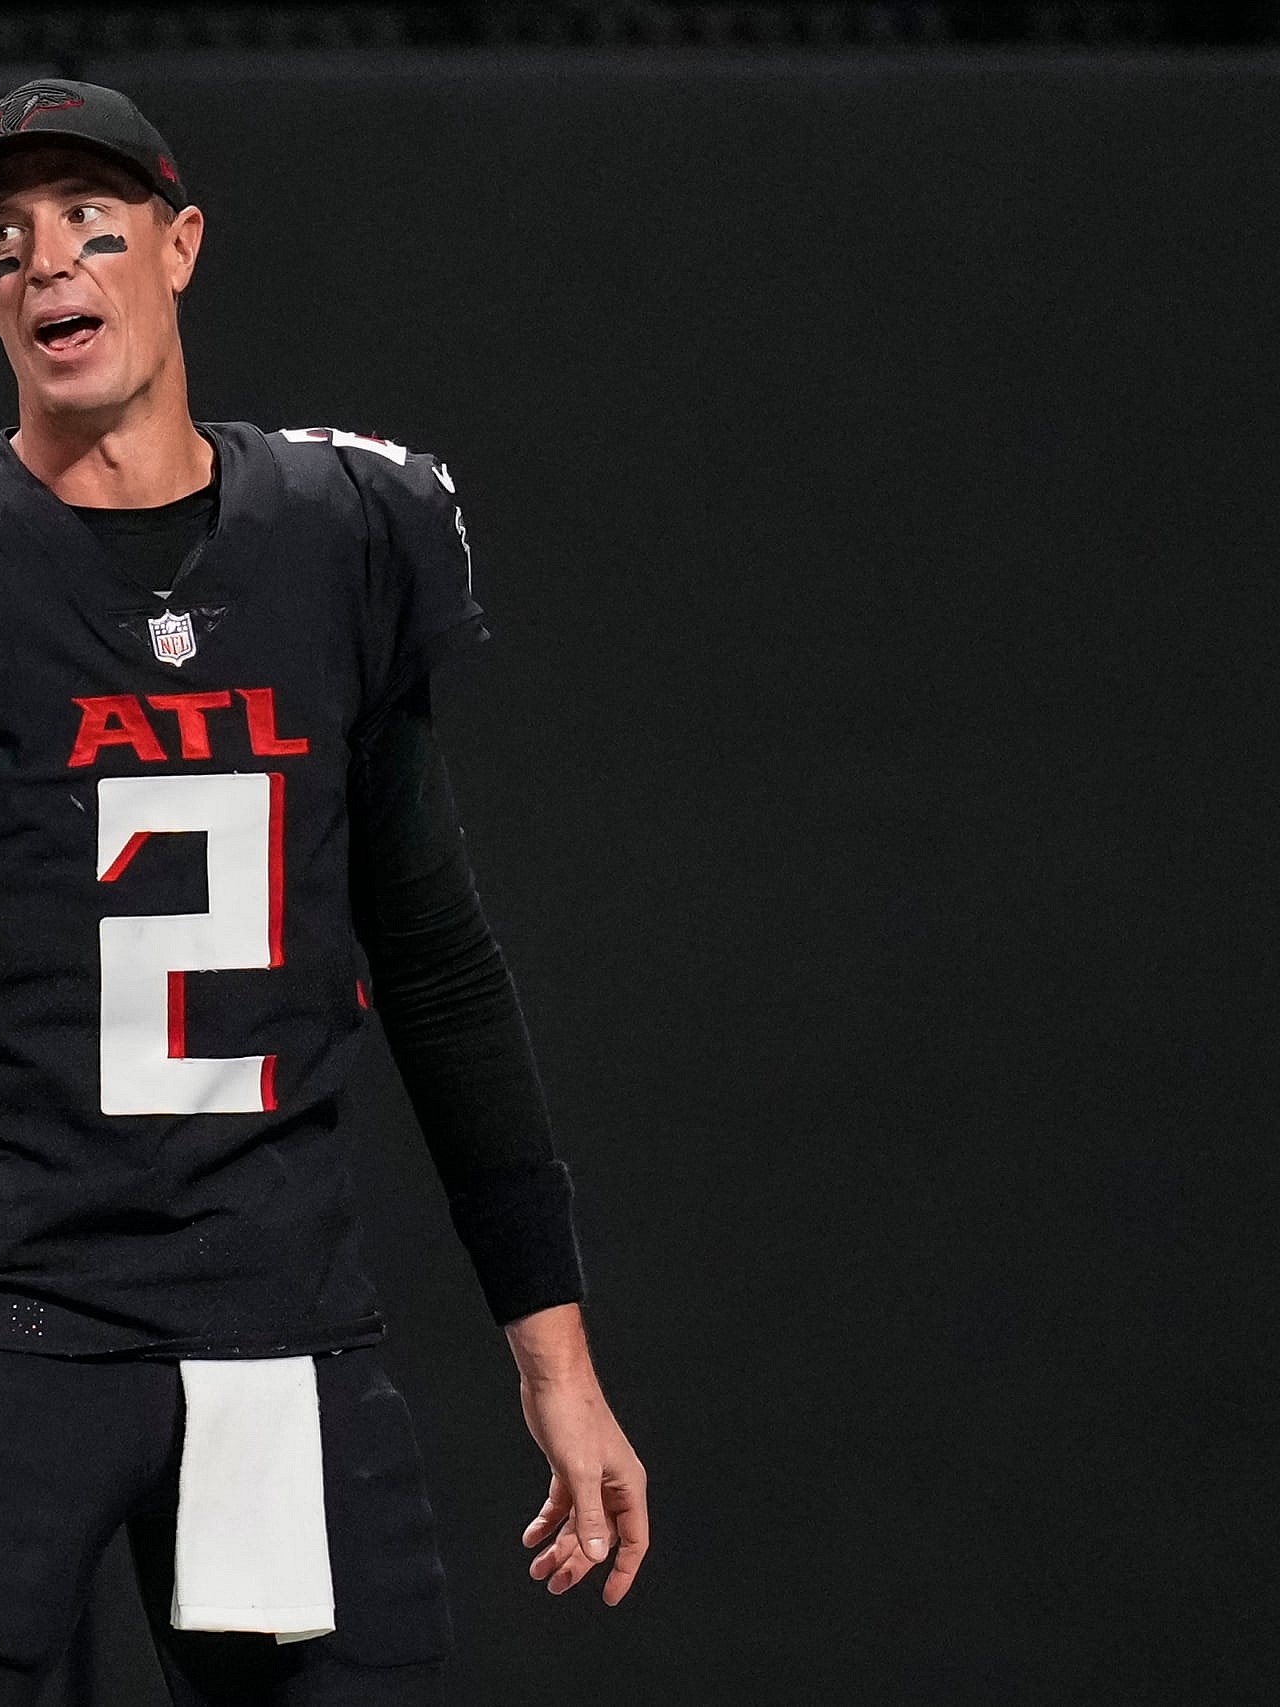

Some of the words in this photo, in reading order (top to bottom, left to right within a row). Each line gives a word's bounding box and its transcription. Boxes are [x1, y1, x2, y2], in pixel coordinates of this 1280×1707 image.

[159, 634, 189, 655] NFL
[67, 687, 310, 767] ATL
[96, 772, 285, 1116] 2
